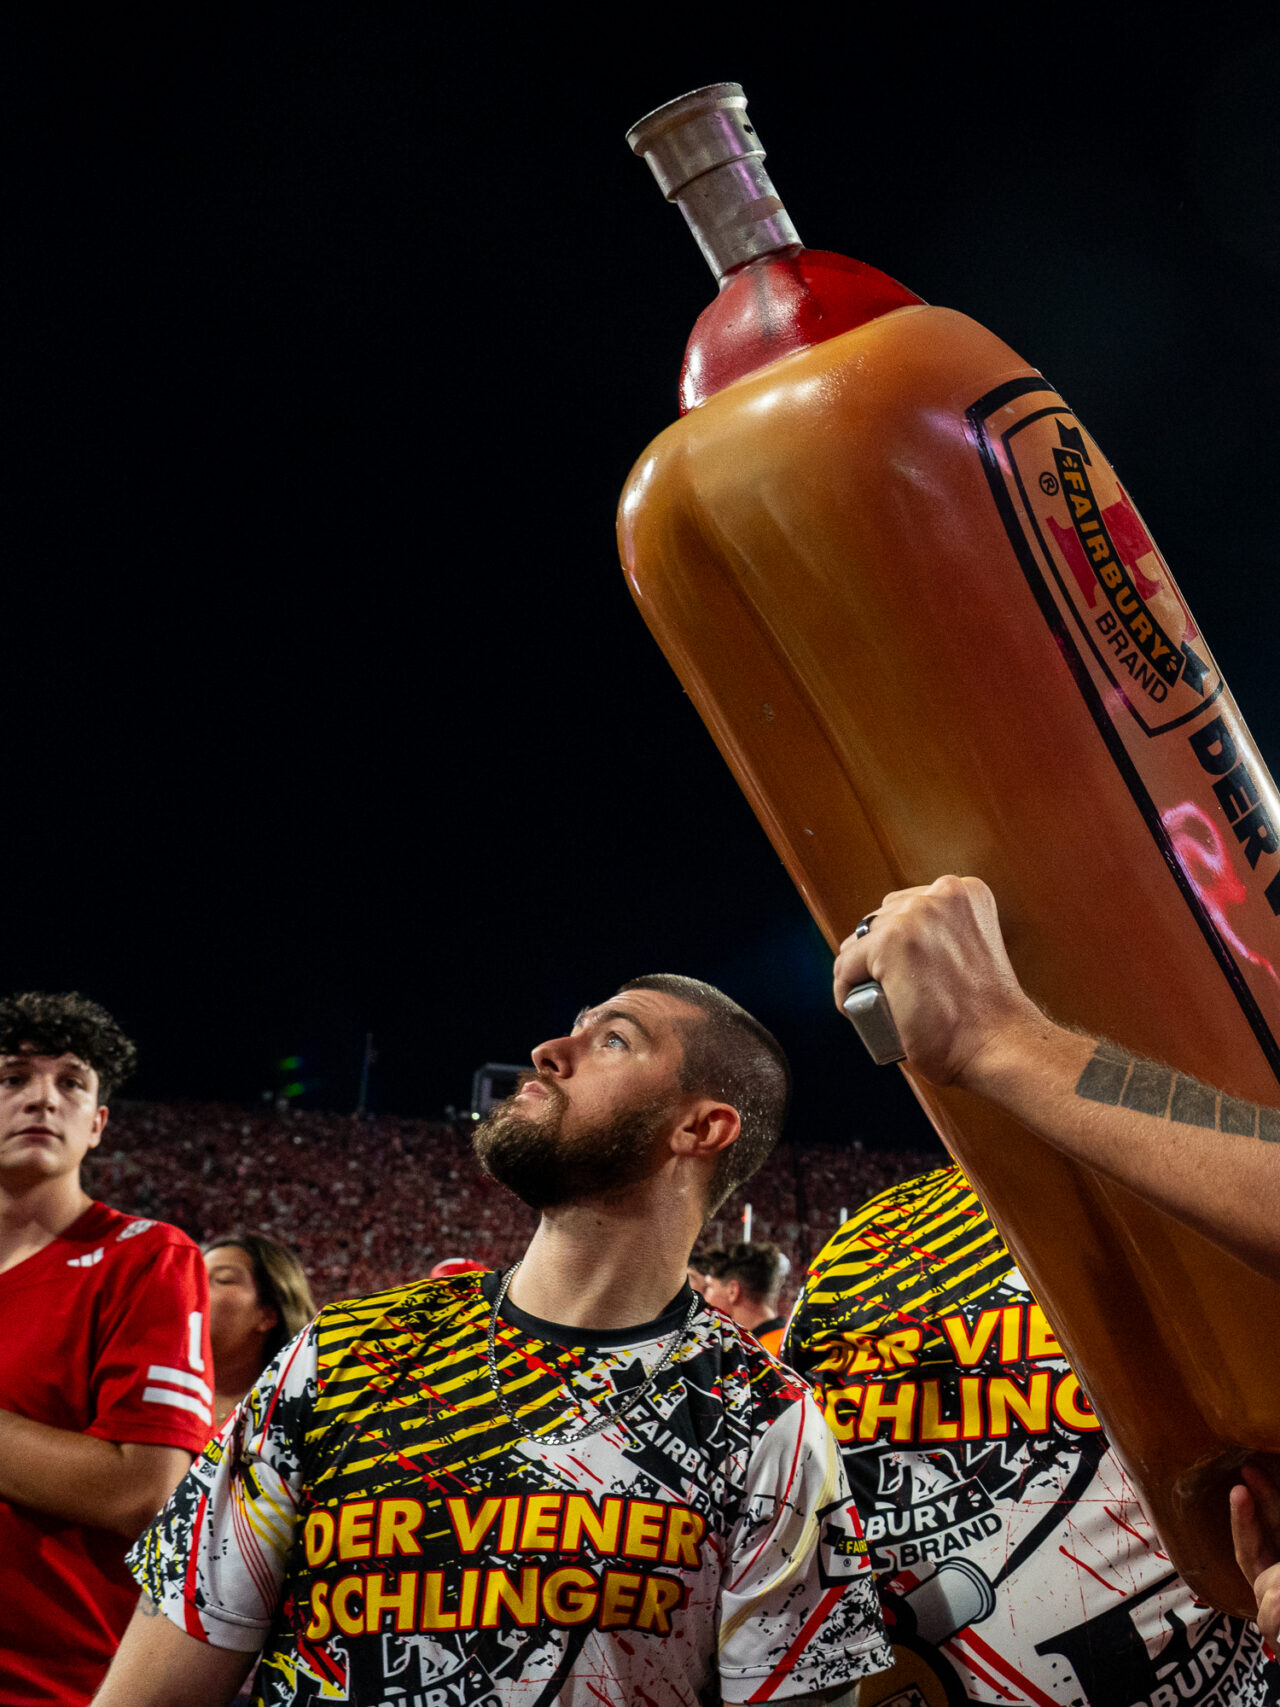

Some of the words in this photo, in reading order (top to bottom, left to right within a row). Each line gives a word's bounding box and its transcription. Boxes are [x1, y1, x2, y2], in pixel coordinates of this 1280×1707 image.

[1062, 470, 1171, 660] FAIRBURY
[1096, 611, 1168, 703] BRAND
[1188, 714, 1279, 870] DER
[304, 1498, 425, 1569] DER
[446, 1492, 706, 1572] VIENER
[901, 1512, 1003, 1568] BRAND
[305, 1566, 682, 1642] SCHLINGER
